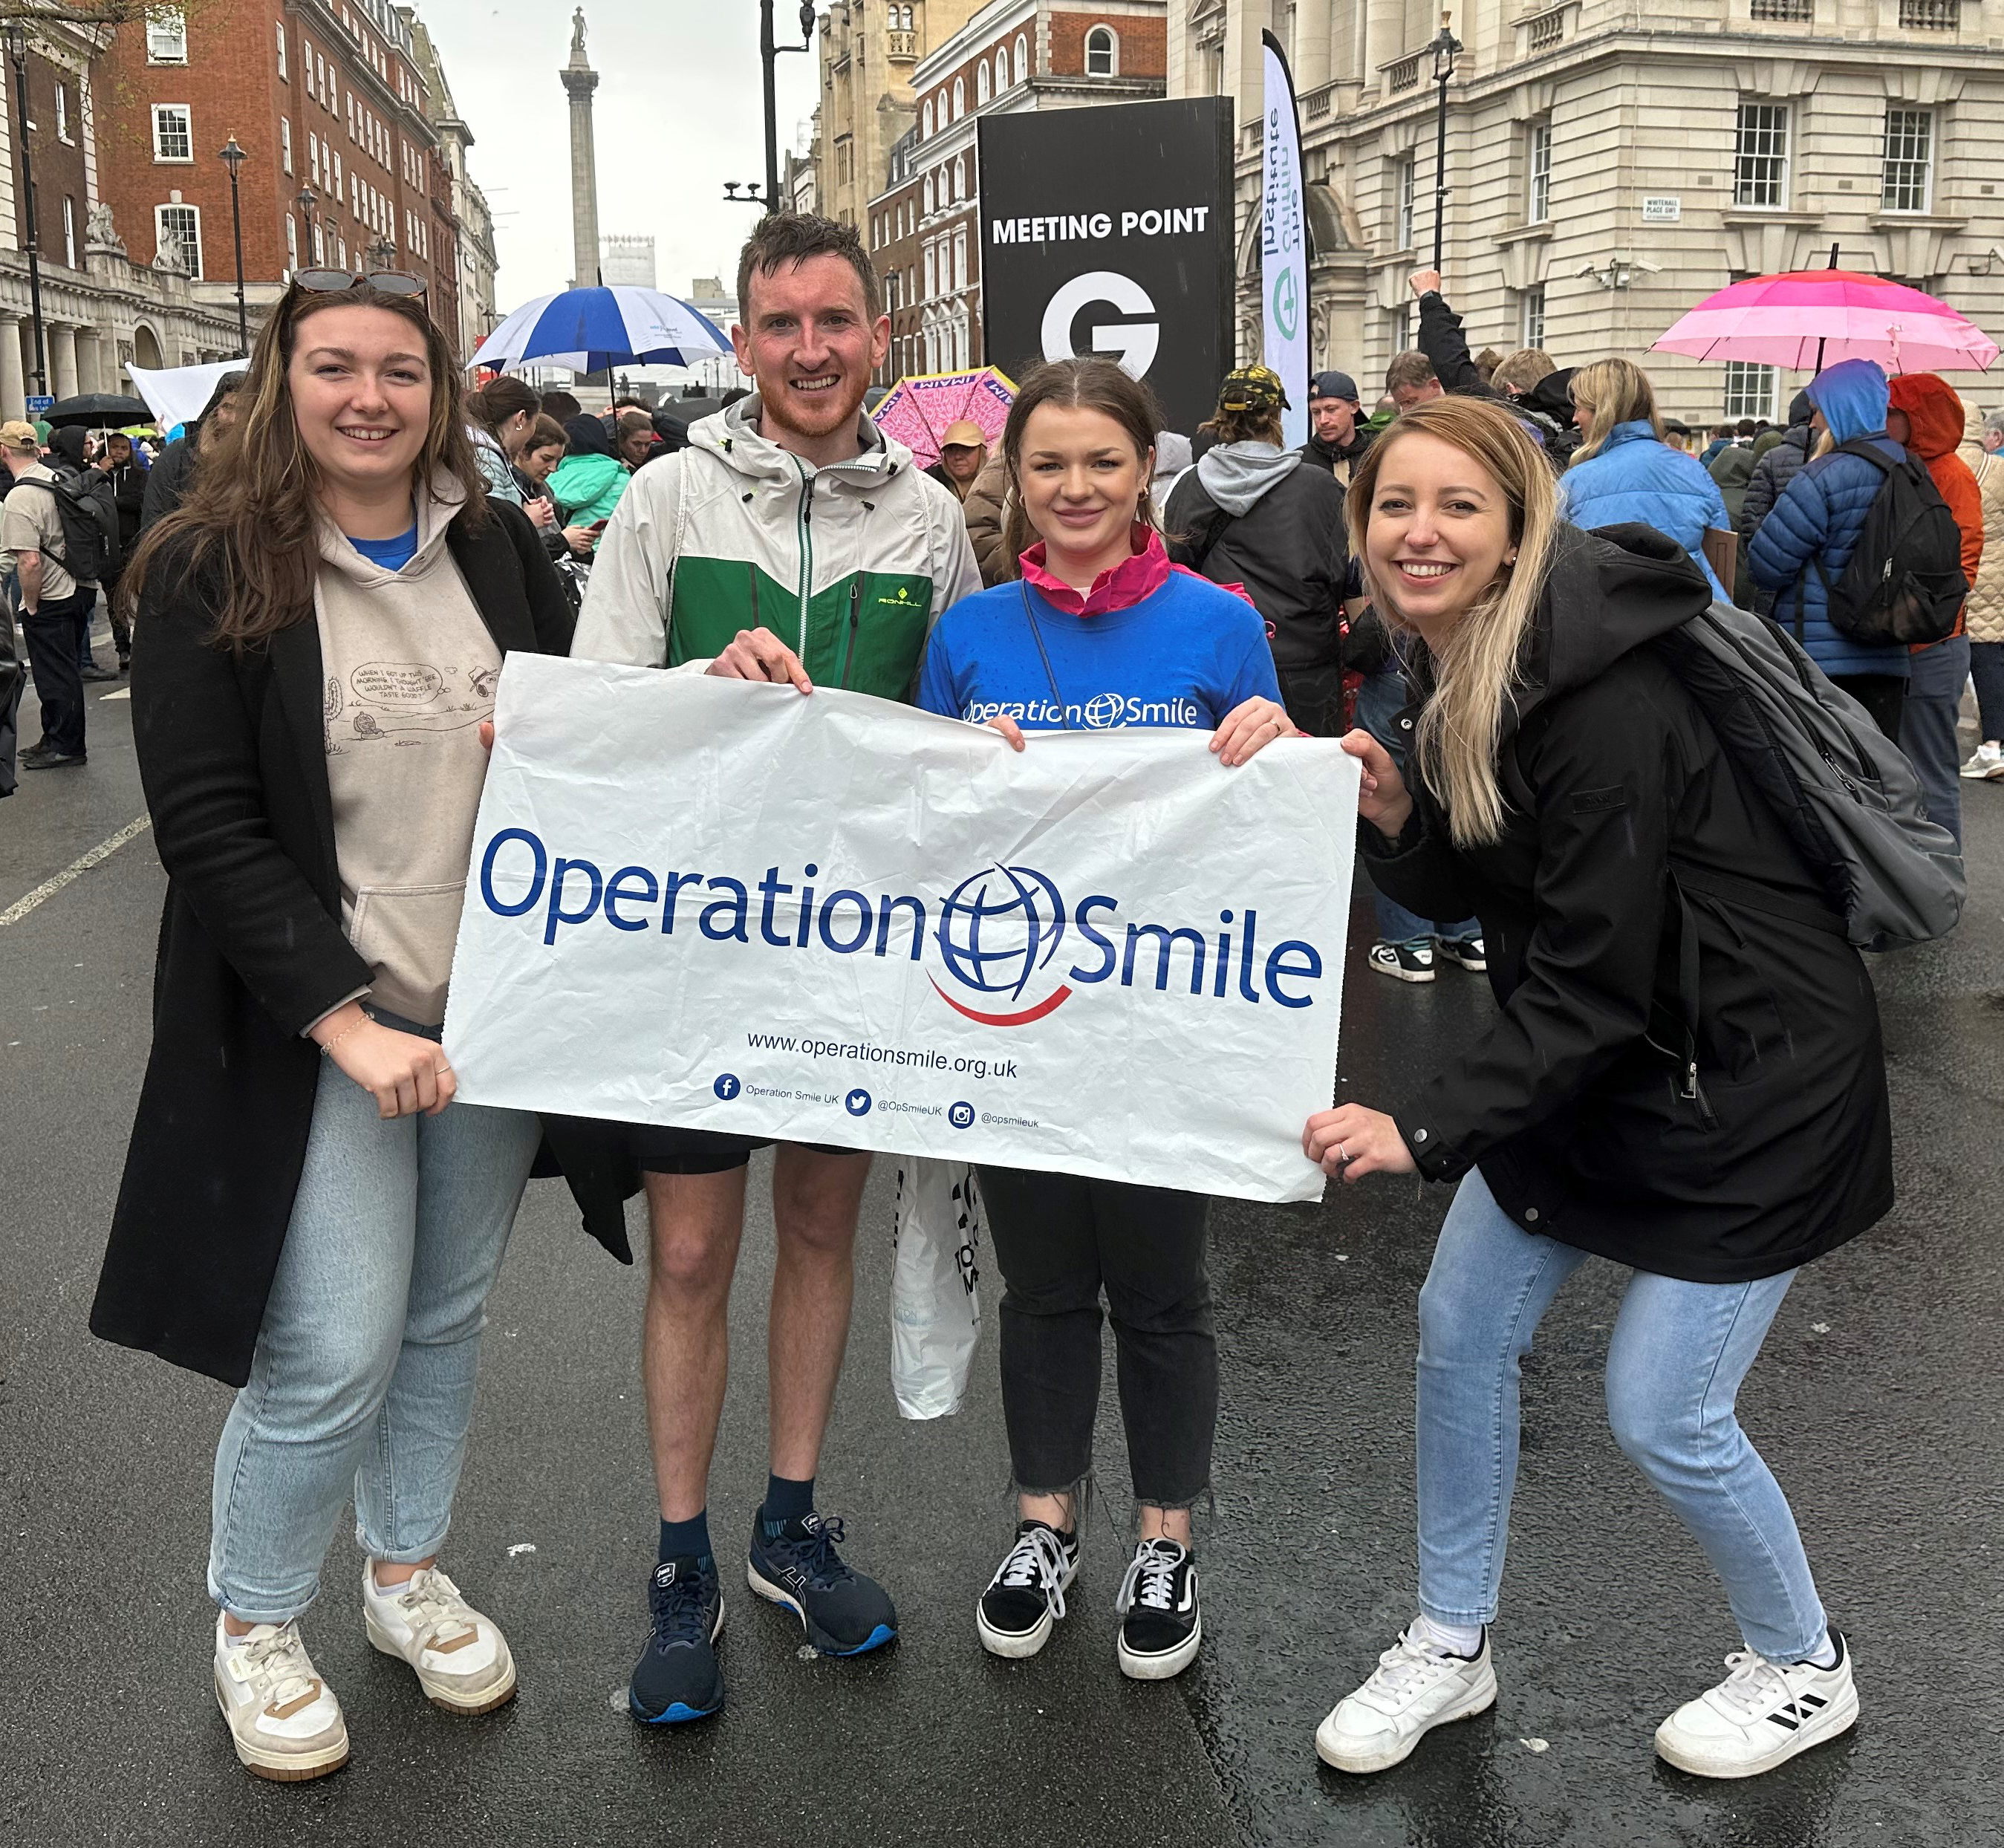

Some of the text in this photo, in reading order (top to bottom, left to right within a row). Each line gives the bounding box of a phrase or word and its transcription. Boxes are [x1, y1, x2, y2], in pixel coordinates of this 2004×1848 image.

[992, 206, 1209, 244] MEETING POINT
[1041, 270, 1160, 383] G
[406, 683, 432, 692] WAFFLE
[963, 697, 1197, 725] Operation Smile
[480, 827, 1322, 1009] Operation Smile
[747, 1032, 1018, 1079] www.operationsmile.org.uk
[746, 1084, 839, 1104] Operation Smile UK
[877, 1099, 943, 1116] @OpSmileUK
[980, 1112, 1040, 1128] @opsmileuk
